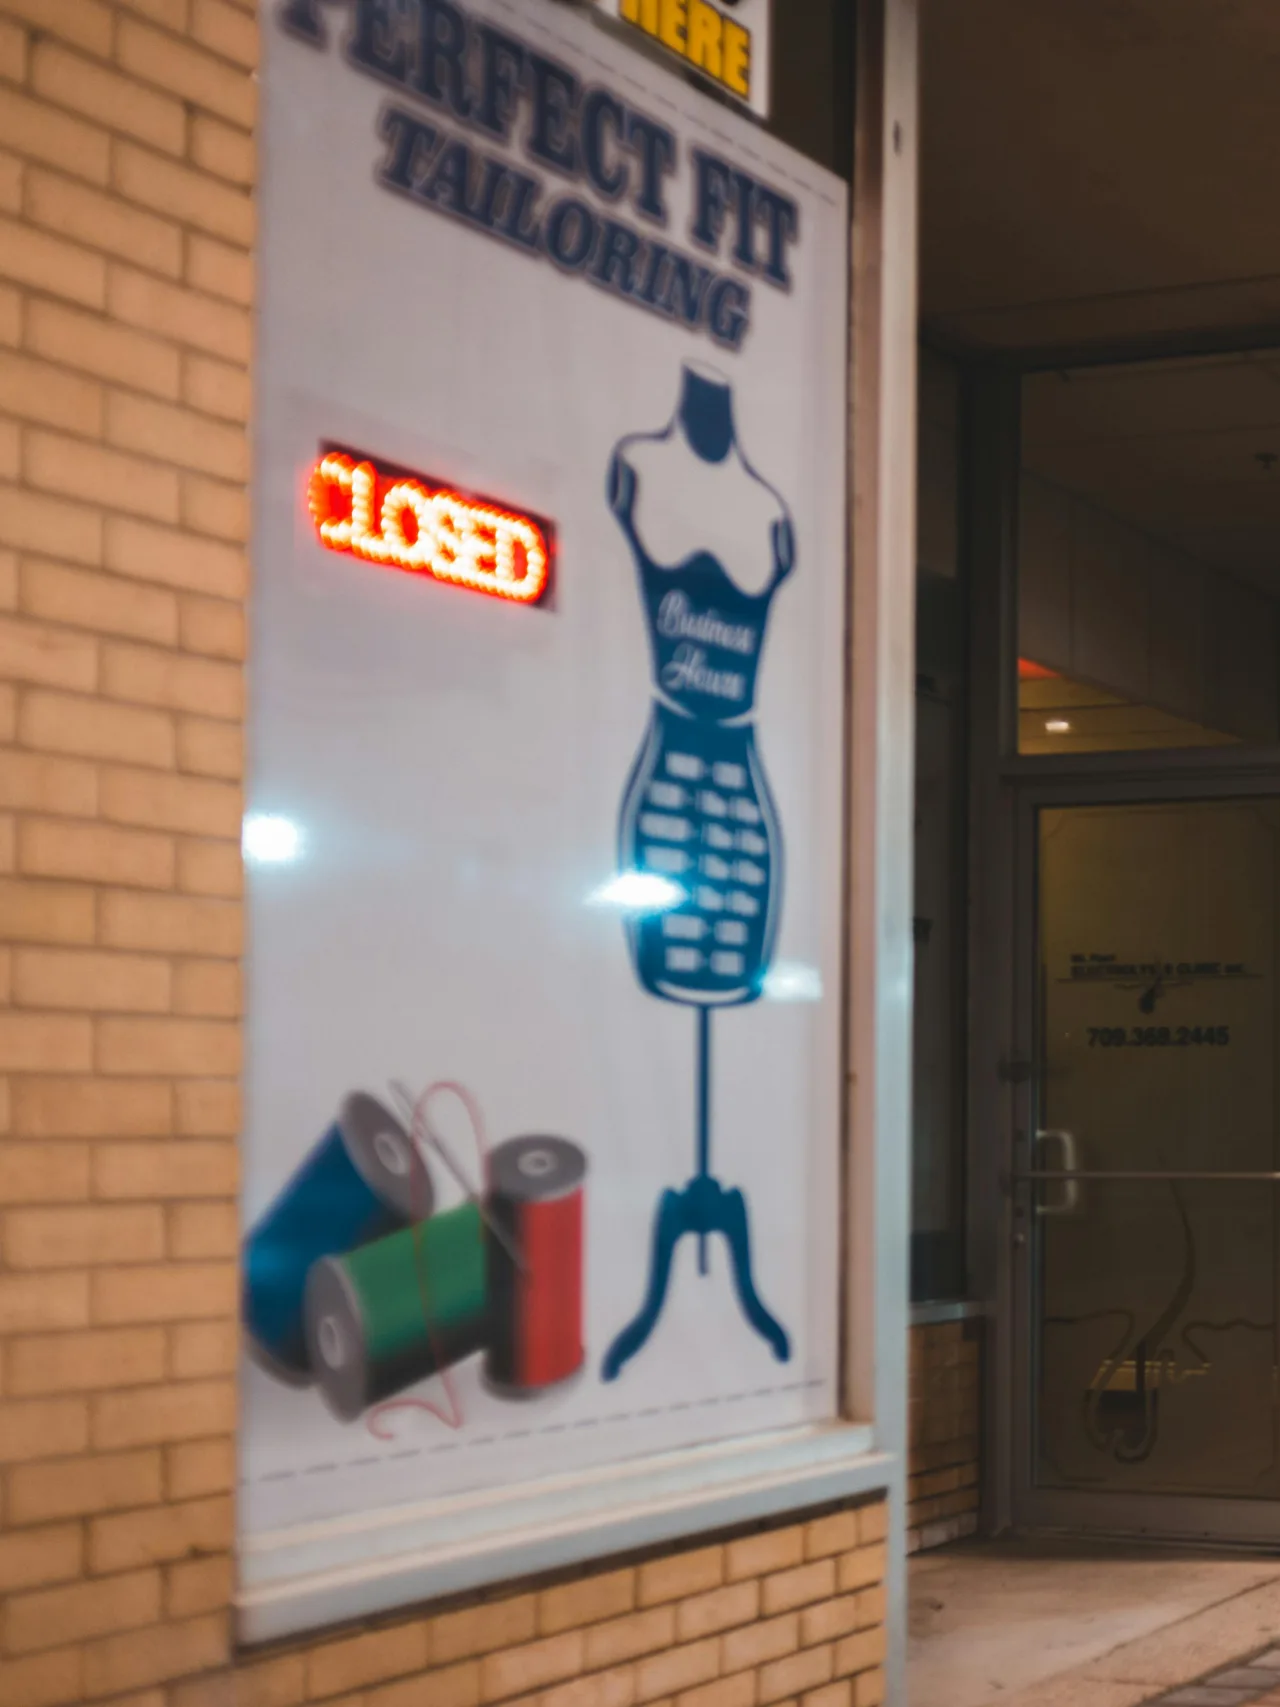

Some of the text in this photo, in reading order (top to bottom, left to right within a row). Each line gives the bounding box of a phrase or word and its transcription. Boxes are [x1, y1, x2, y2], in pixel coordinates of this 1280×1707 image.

[379, 105, 749, 348] TAILORING
[690, 145, 799, 288] FIT
[308, 452, 549, 604] CLOSED
